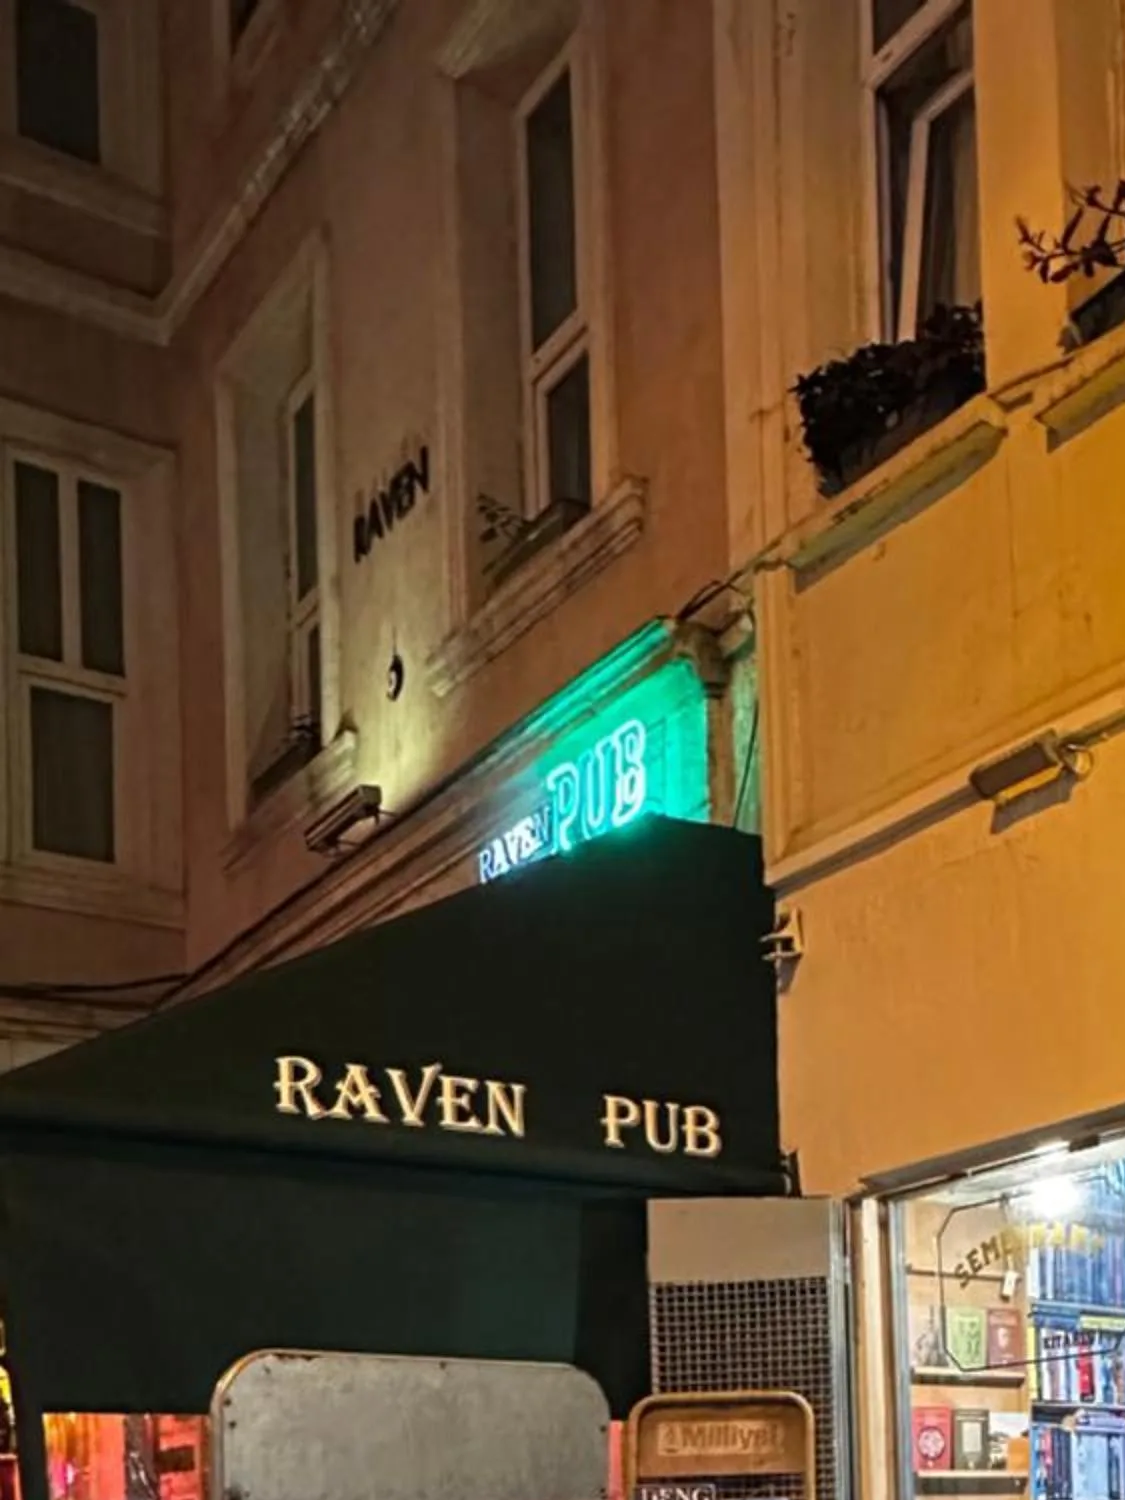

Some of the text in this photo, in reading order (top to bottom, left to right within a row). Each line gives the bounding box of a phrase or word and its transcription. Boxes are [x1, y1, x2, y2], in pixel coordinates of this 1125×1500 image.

[354, 445, 430, 564] RAVEN
[479, 719, 647, 884] RAVEN PUB
[273, 1056, 722, 1158] RAVEN PUB
